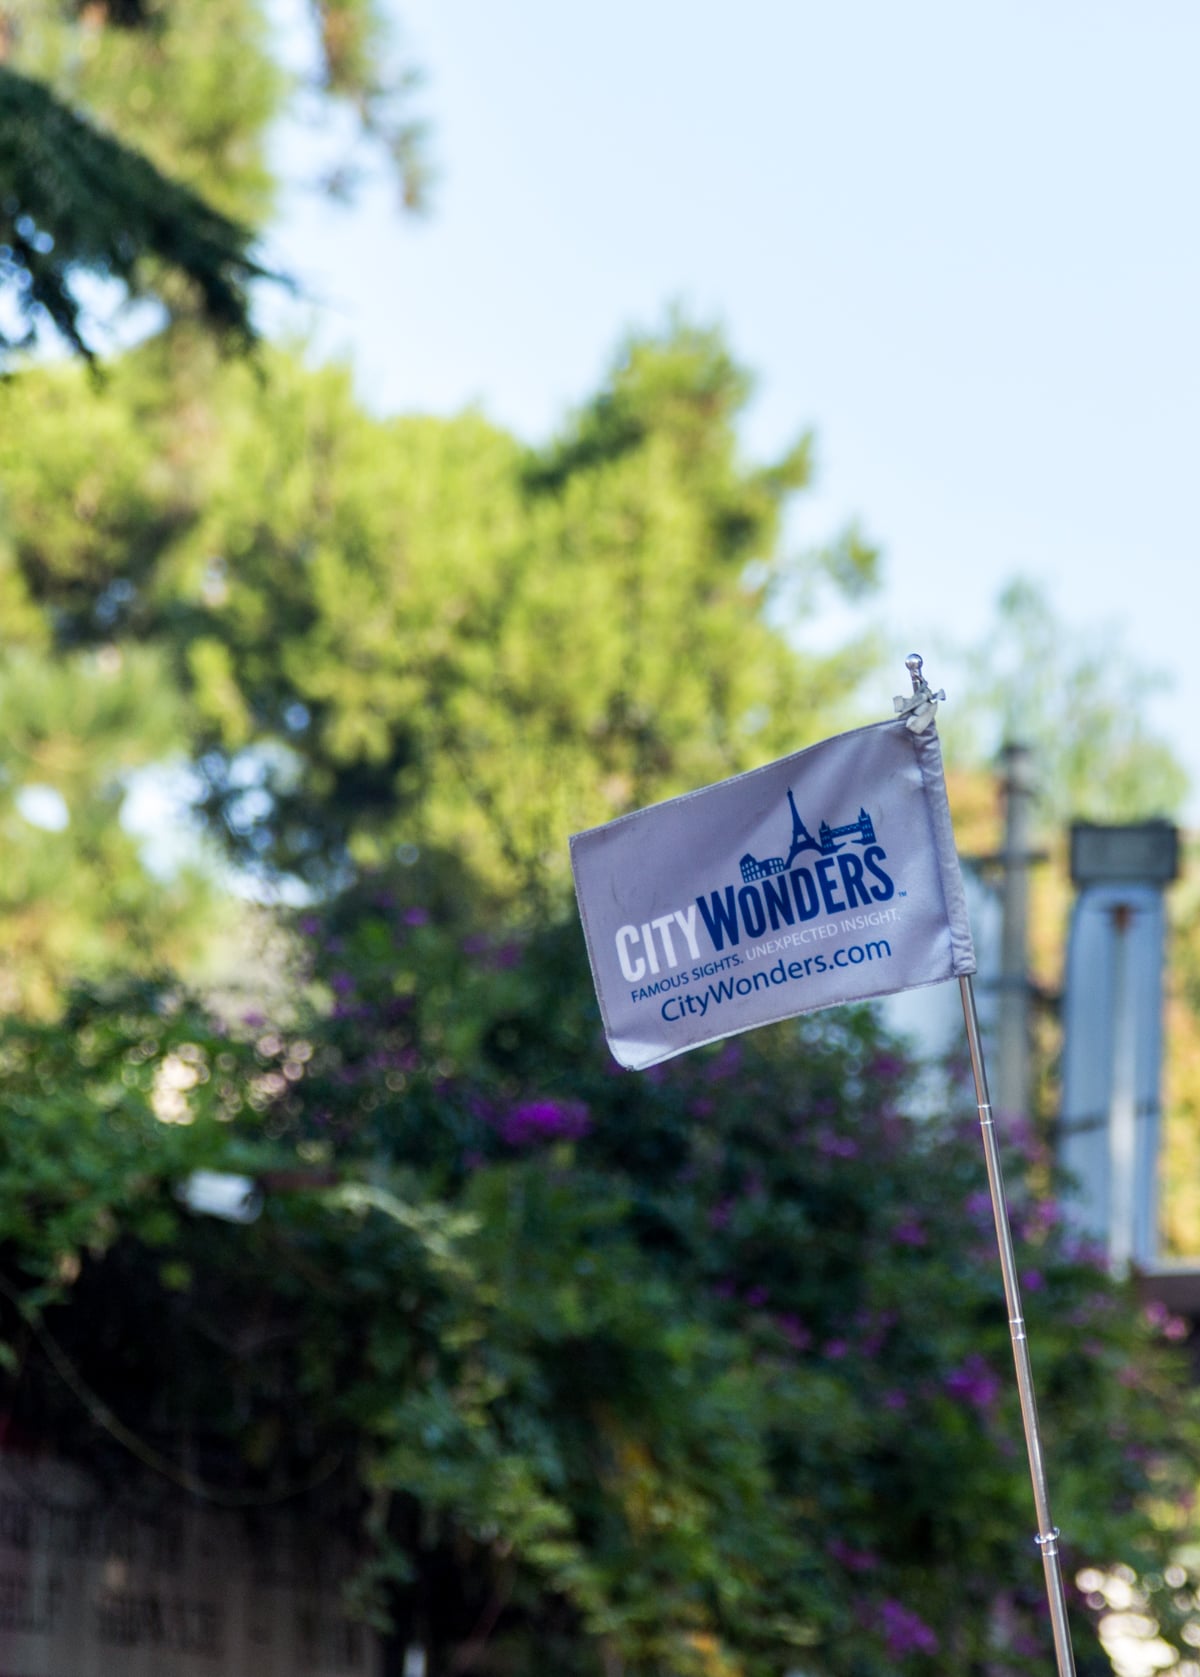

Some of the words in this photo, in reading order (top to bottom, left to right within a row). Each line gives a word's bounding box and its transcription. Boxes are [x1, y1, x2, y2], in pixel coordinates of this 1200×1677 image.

[631, 972, 689, 1003] FAMOUS
[692, 954, 744, 981] SIGHTS.
[745, 923, 838, 961] UNEXPECTED
[841, 908, 901, 933] INSIGHT.
[661, 939, 892, 1022] CityWonders.com
